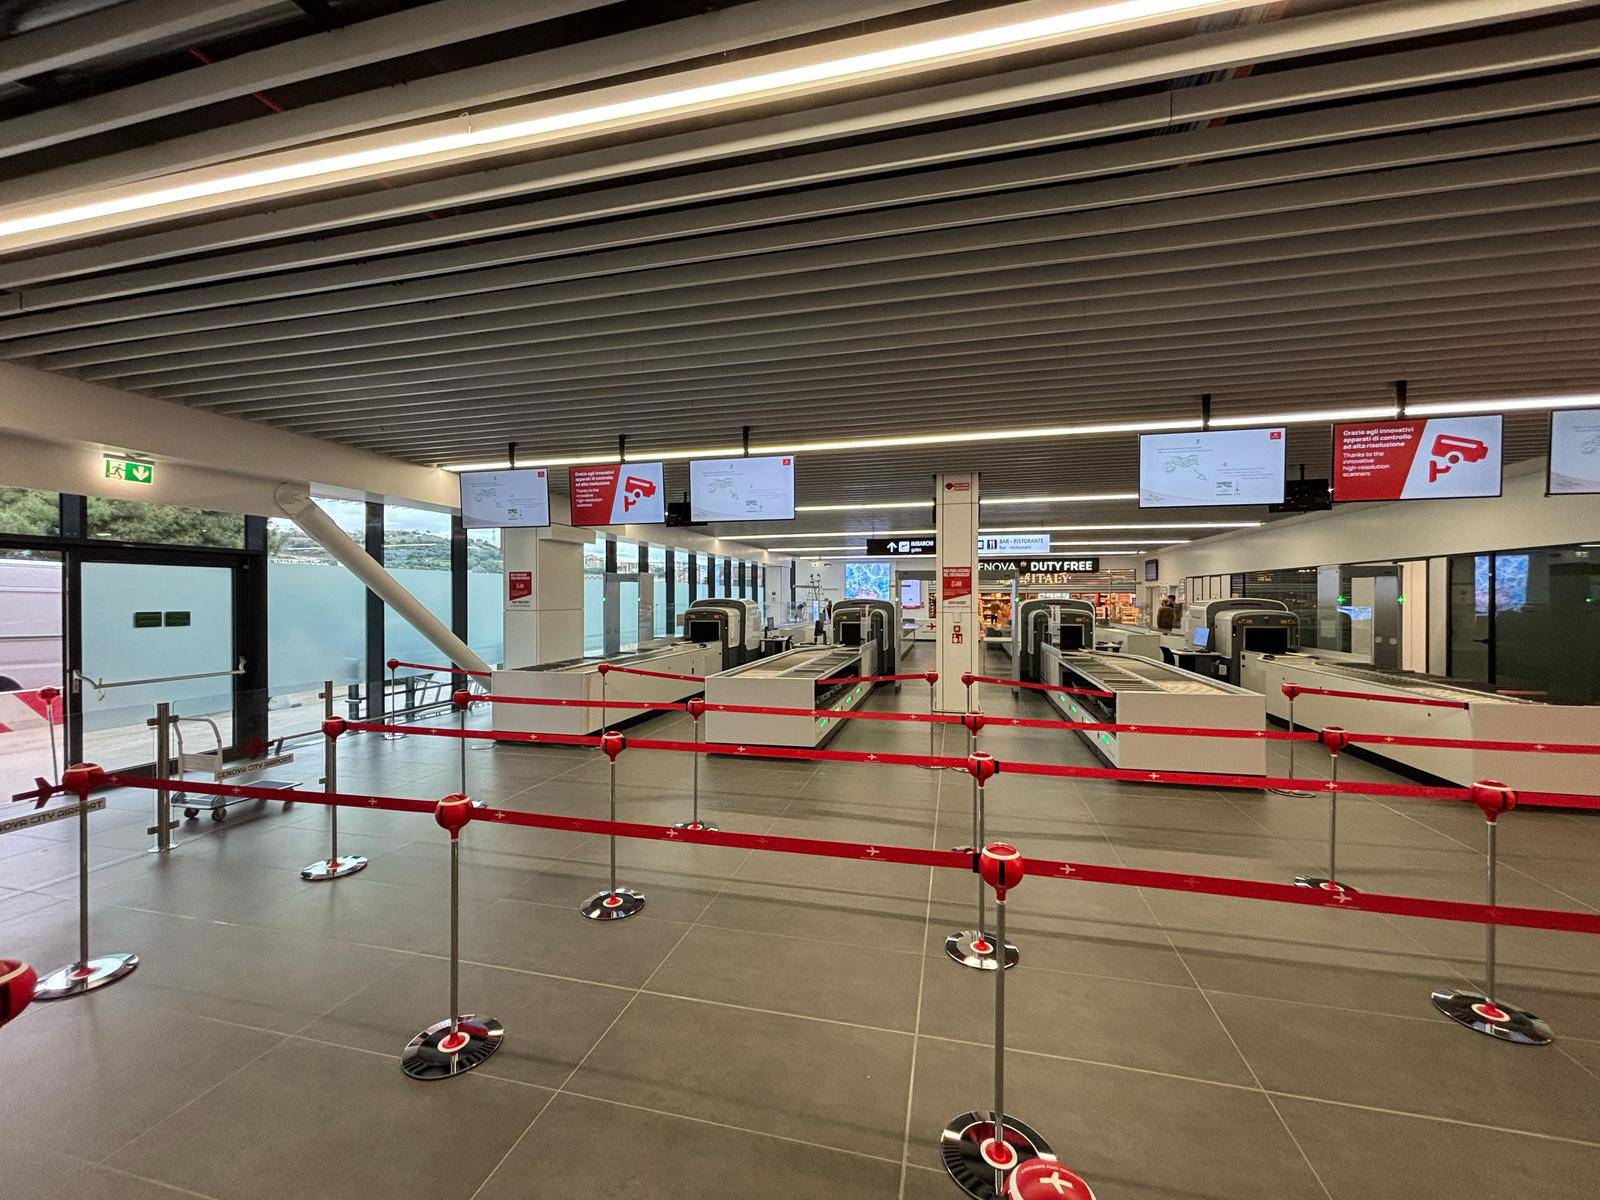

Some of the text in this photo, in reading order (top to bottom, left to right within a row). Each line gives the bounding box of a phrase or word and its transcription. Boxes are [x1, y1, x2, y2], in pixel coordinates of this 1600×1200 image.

[978, 561, 1092, 571] ENOVA DUTY FREE
[1031, 573, 1070, 584] ITALY
[216, 766, 246, 779] GENOVA
[248, 763, 263, 771] CITY
[31, 812, 55, 824] CITY
[57, 800, 103, 817] AIRPRT
